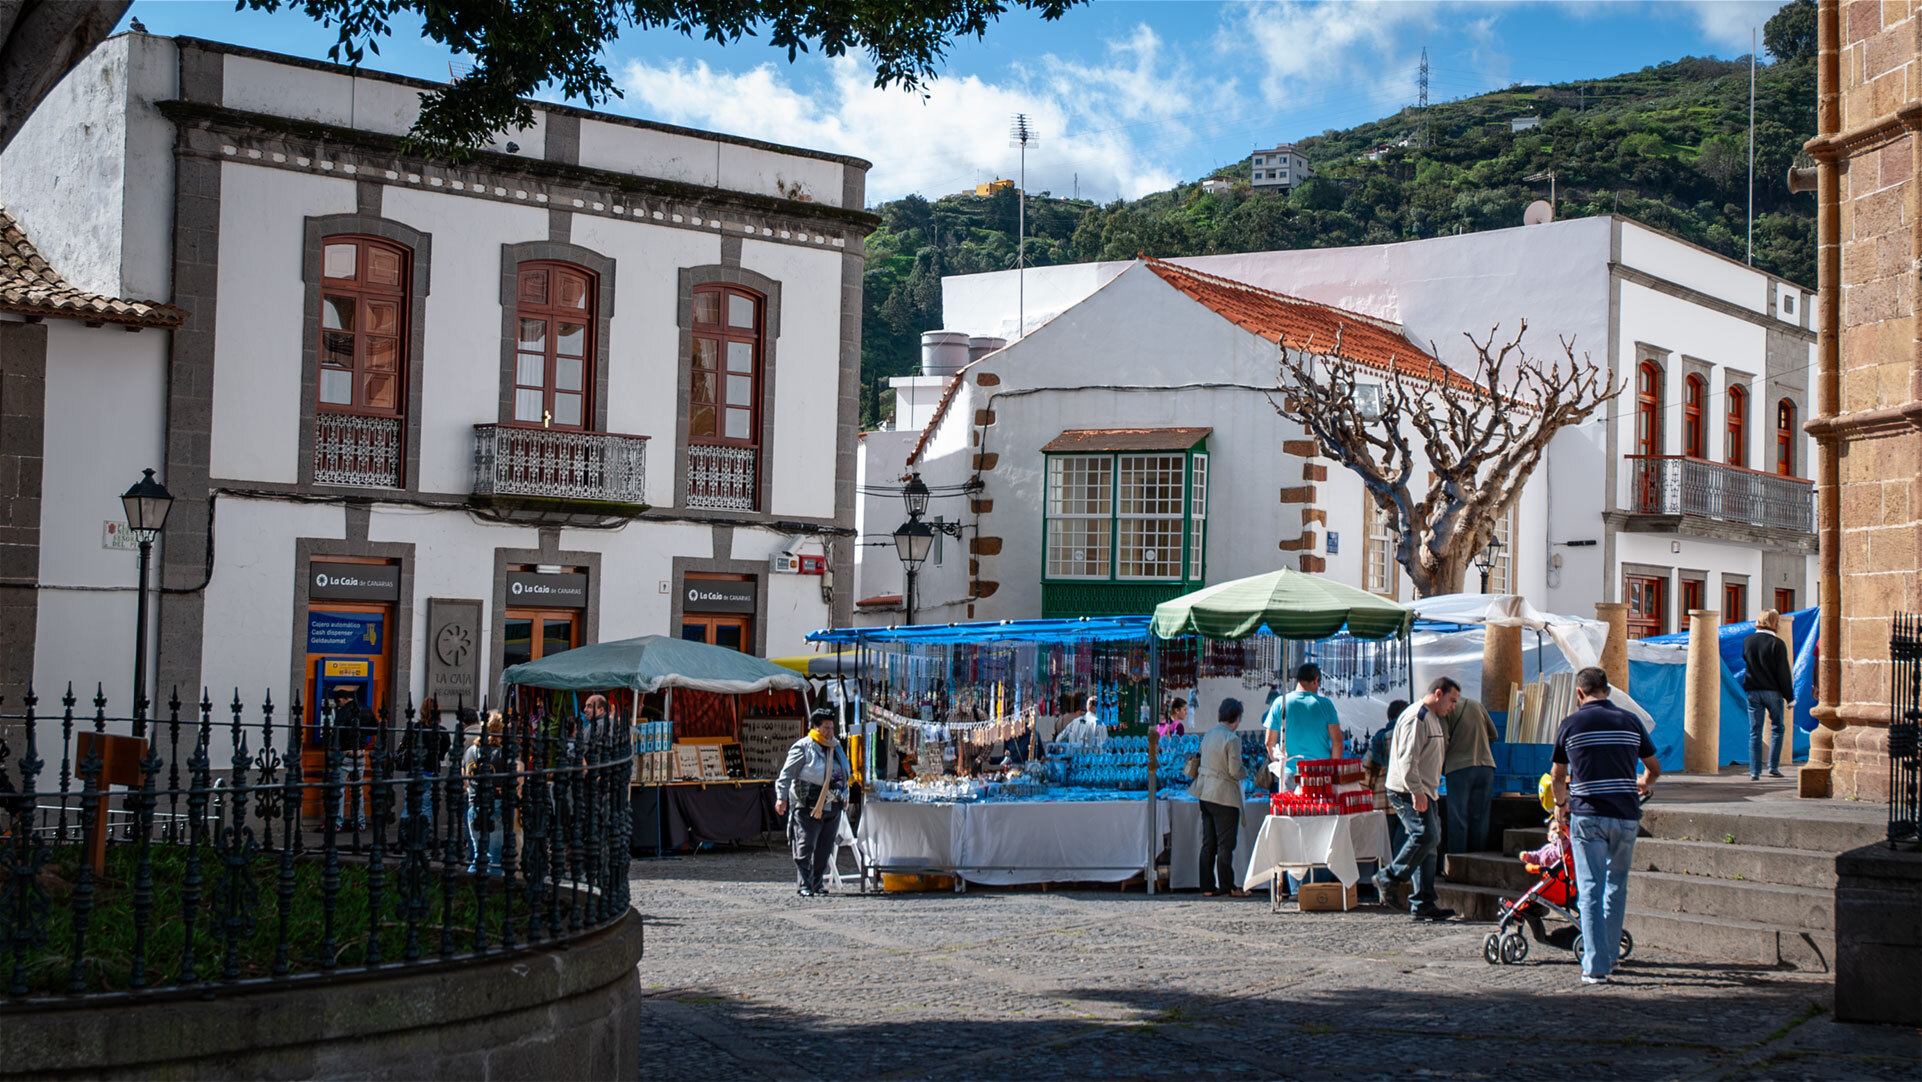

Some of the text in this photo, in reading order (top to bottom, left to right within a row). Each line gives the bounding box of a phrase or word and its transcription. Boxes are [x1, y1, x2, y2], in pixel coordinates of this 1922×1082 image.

[330, 577, 339, 585] La
[340, 577, 358, 586] Caja
[367, 580, 393, 588] CANARIAS
[524, 584, 533, 593] La
[534, 585, 550, 594] Caja
[700, 592, 708, 600] La
[708, 592, 723, 600] Caja
[327, 629, 353, 637] dispenser
[435, 673, 472, 686] LA CAJA
